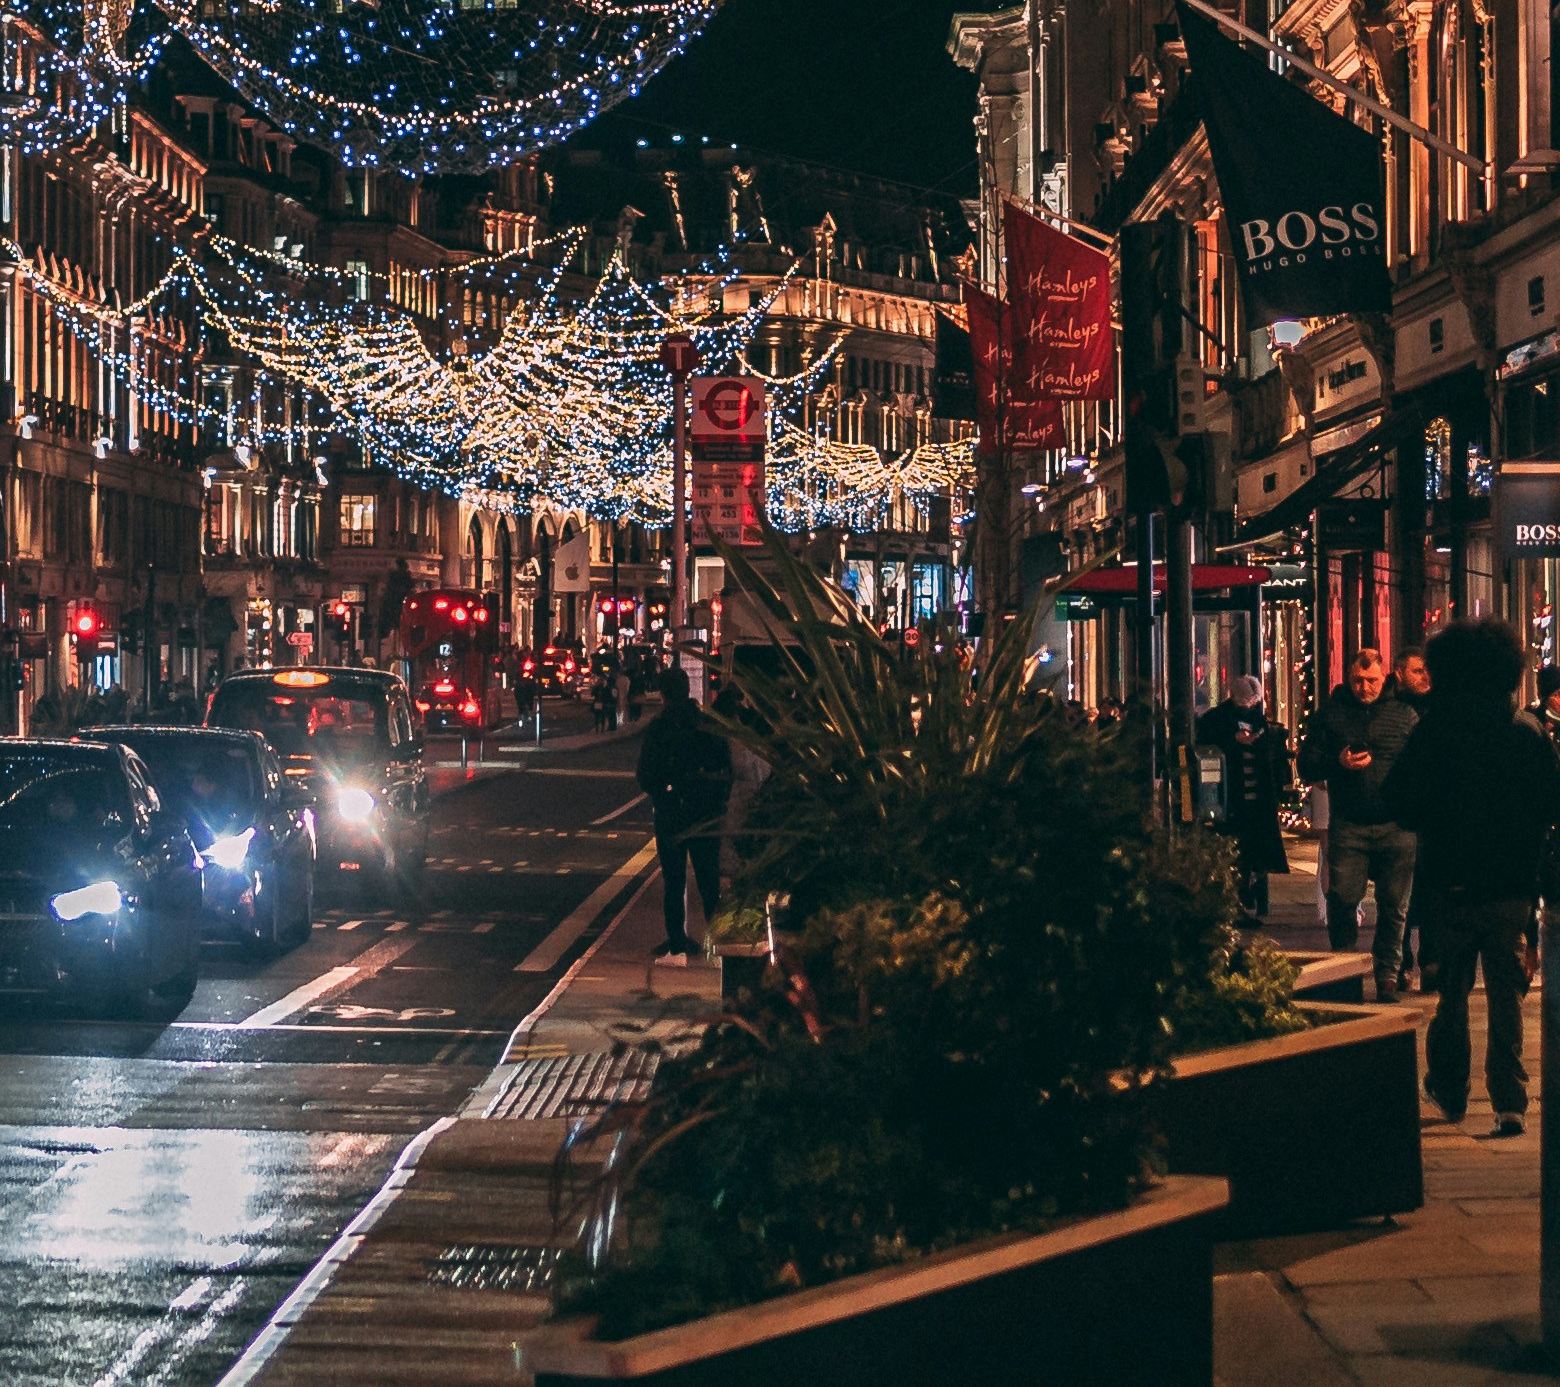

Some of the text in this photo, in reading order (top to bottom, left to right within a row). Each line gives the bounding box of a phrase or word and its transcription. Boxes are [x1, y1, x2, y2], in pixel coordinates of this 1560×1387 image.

[1240, 202, 1379, 261] BOSS
[1248, 244, 1381, 275] HUGO BOSS
[1023, 264, 1097, 302] Hamleys
[1024, 310, 1099, 350] Hamleys
[1026, 357, 1100, 396] Hamleys
